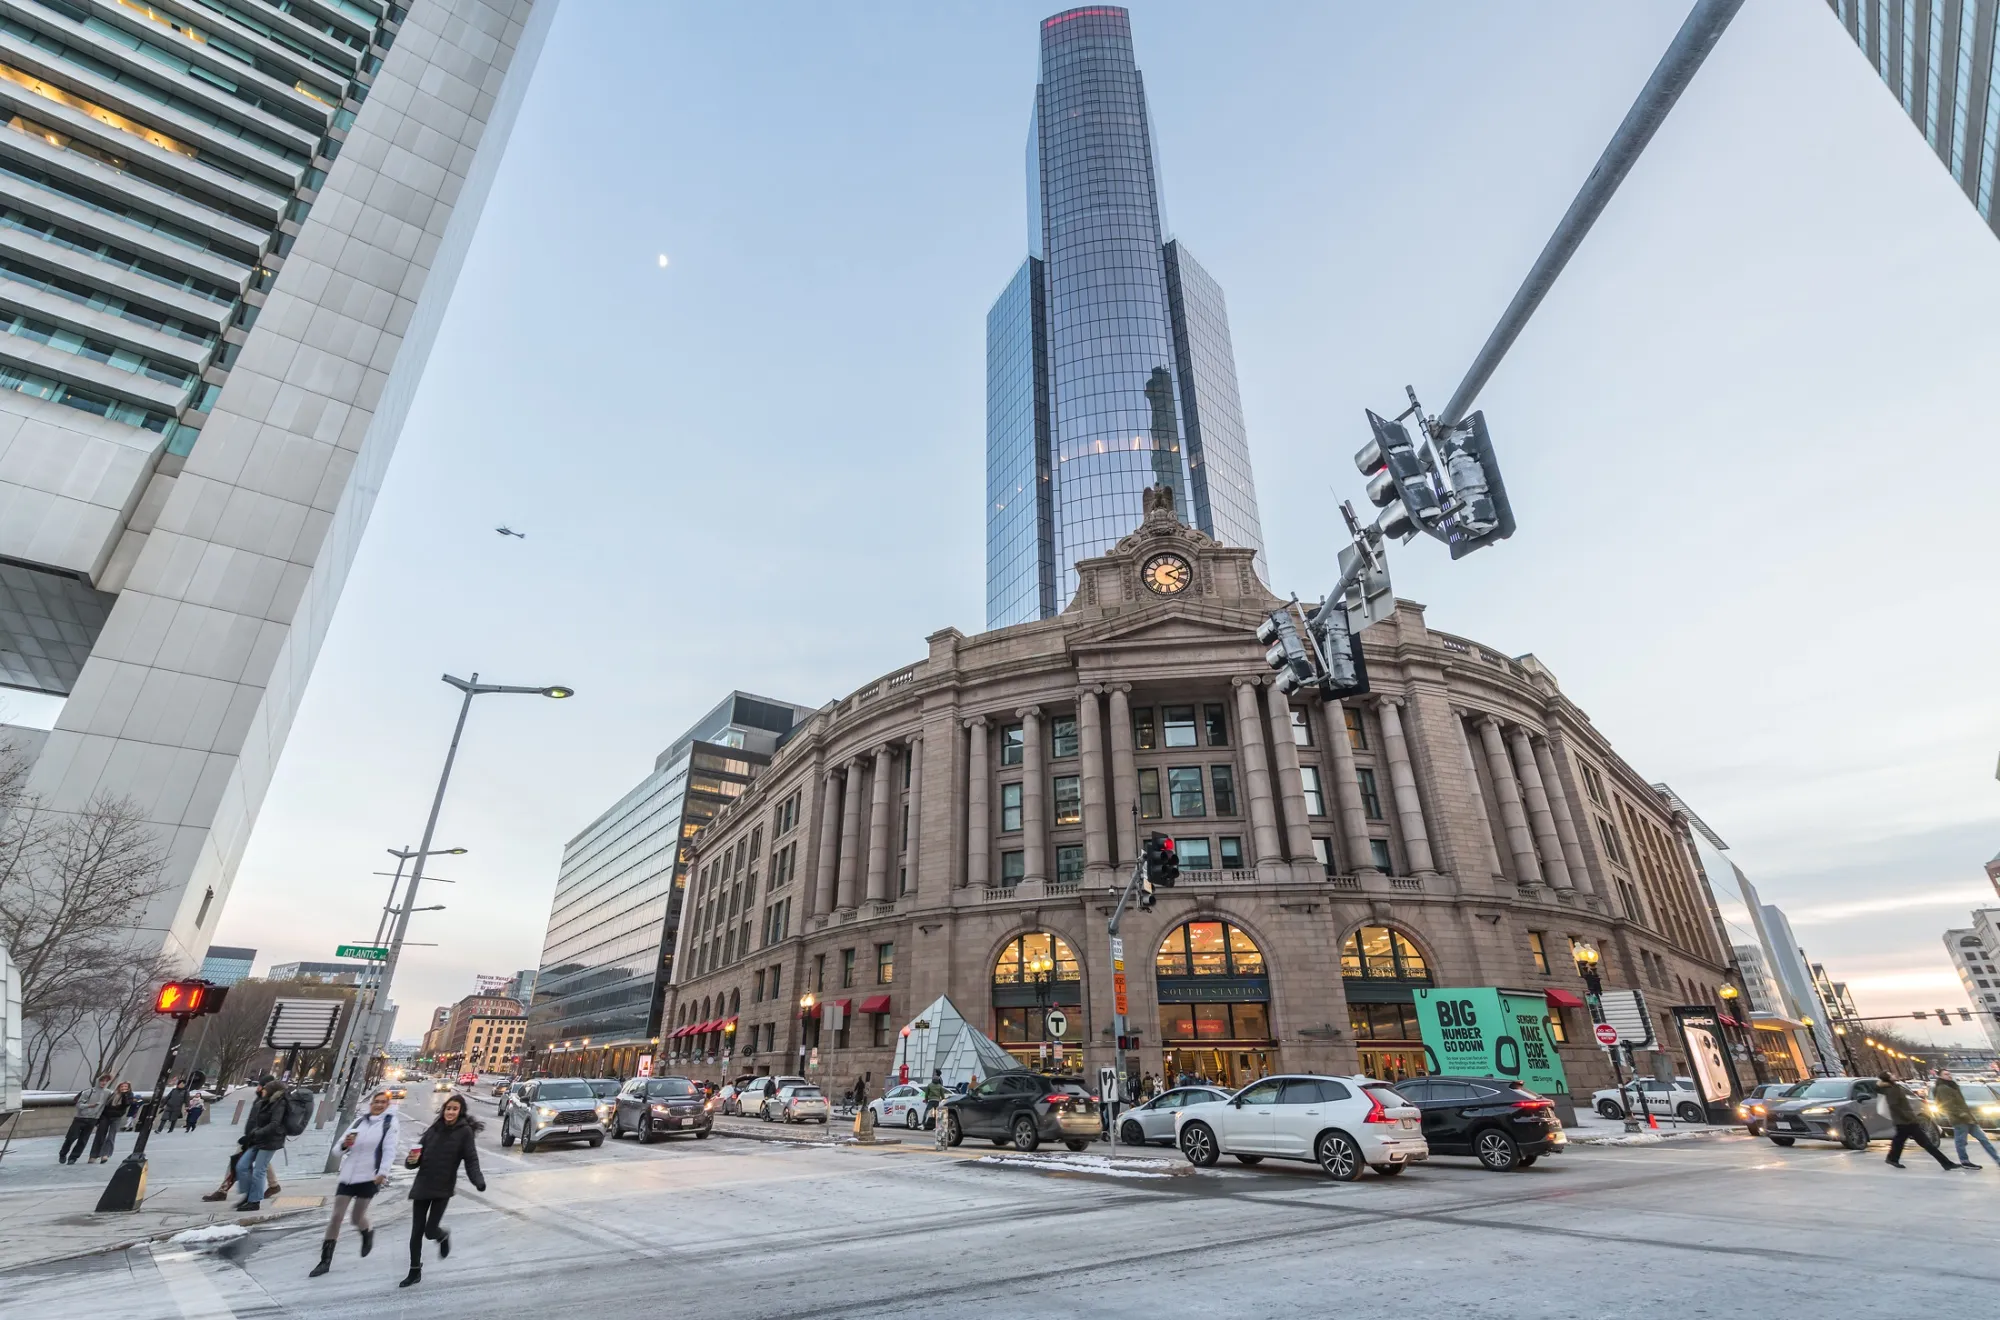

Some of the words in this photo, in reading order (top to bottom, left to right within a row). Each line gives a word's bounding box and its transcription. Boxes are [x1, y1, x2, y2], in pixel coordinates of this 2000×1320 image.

[343, 948, 378, 959] ATLANTIC
[1162, 988, 1202, 996] SOUTH
[1212, 988, 1263, 996] STATION
[1436, 1000, 1477, 1026] BIG
[1051, 1017, 1064, 1033] T
[1441, 1028, 1482, 1040] NUMBER
[1520, 1026, 1543, 1042] MAKE
[1444, 1041, 1458, 1052] GO
[1458, 1040, 1484, 1052] DOWN
[1524, 1043, 1547, 1058] CODE
[1528, 1059, 1550, 1069] STRONG
